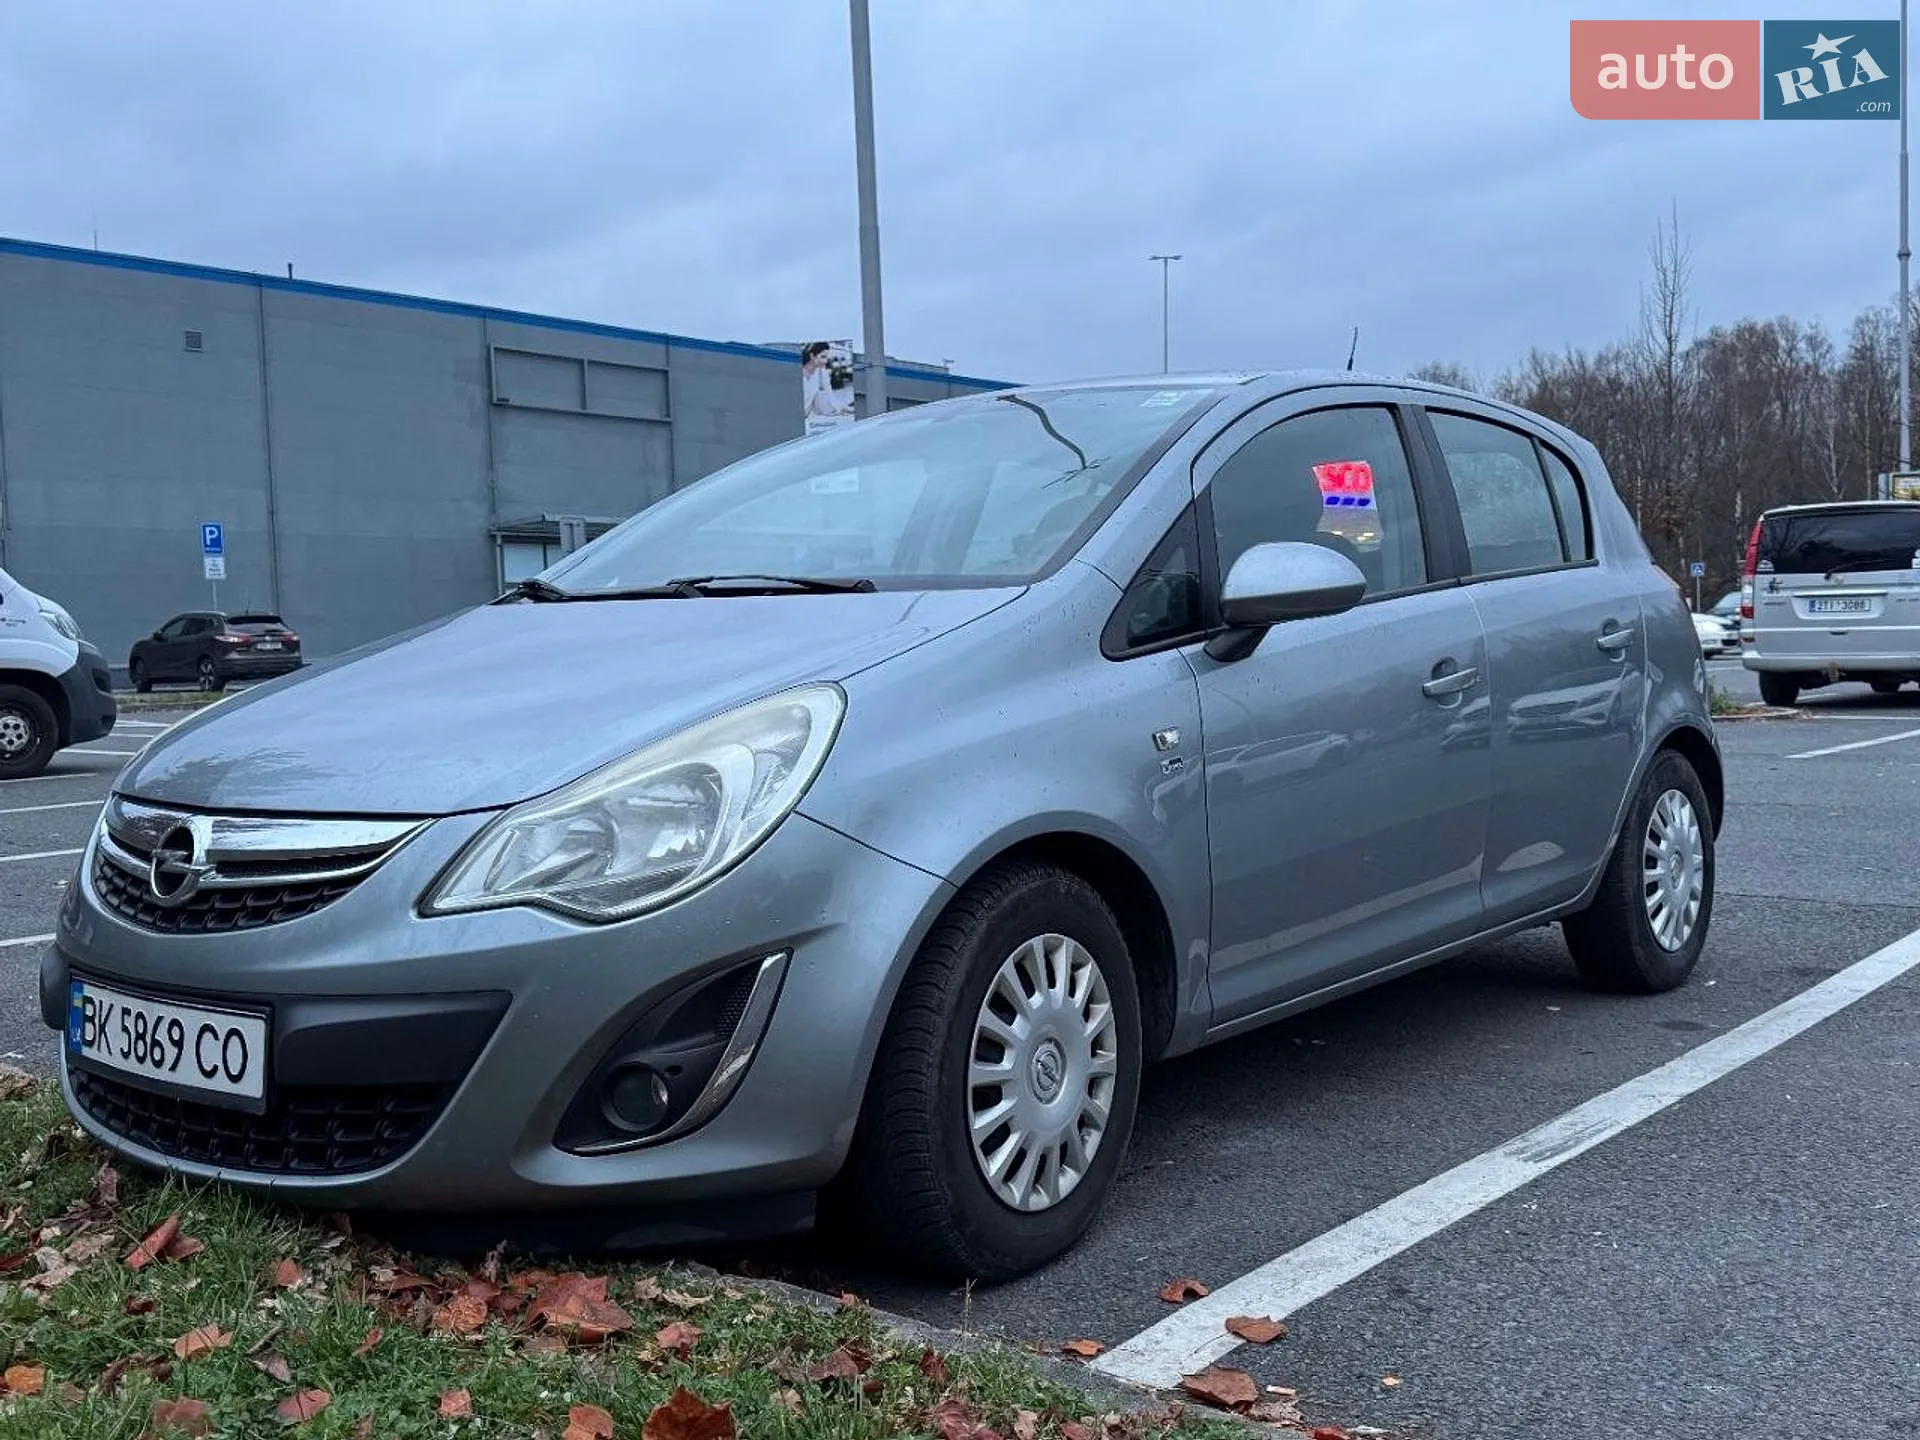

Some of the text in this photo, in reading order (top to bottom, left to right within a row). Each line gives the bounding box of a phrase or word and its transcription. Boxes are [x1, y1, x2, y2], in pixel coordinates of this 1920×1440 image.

[205, 526, 219, 546] P
[82, 995, 248, 1084] BK 5869 CO
